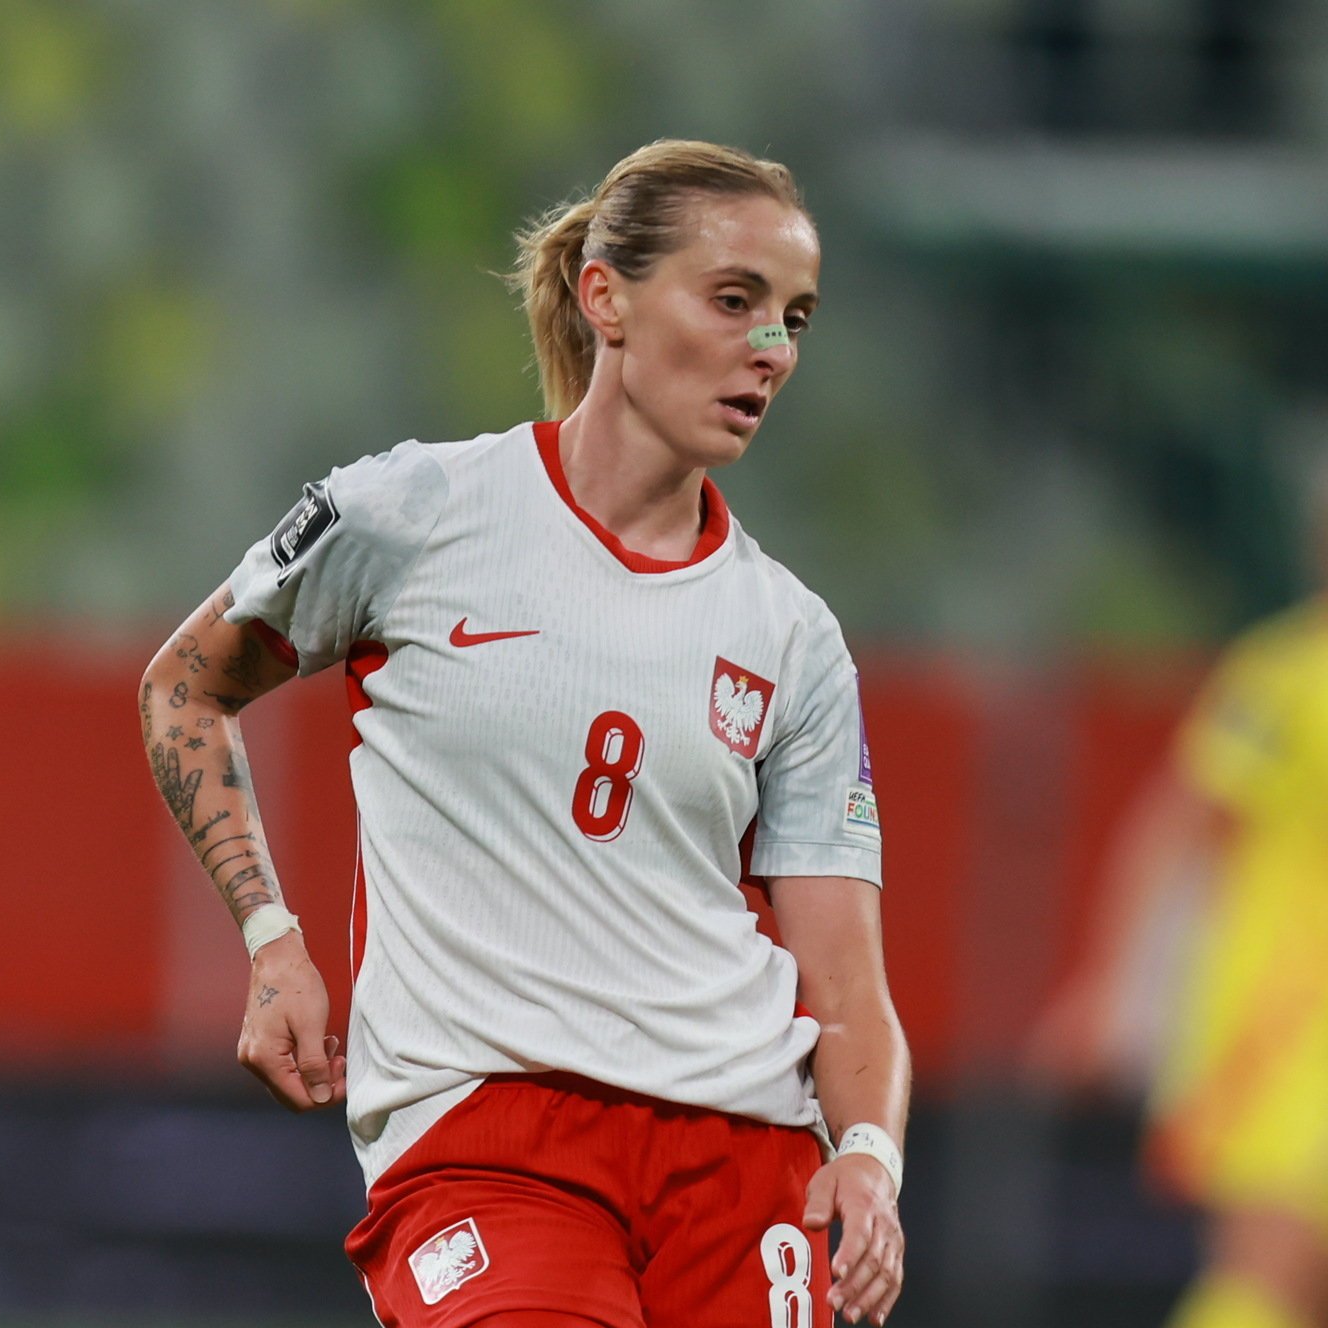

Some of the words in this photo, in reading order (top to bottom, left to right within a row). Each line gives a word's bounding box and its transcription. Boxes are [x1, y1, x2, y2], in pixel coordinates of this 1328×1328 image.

[572, 710, 645, 842] 8
[848, 791, 866, 802] UEFA
[847, 802, 879, 823] FOUN
